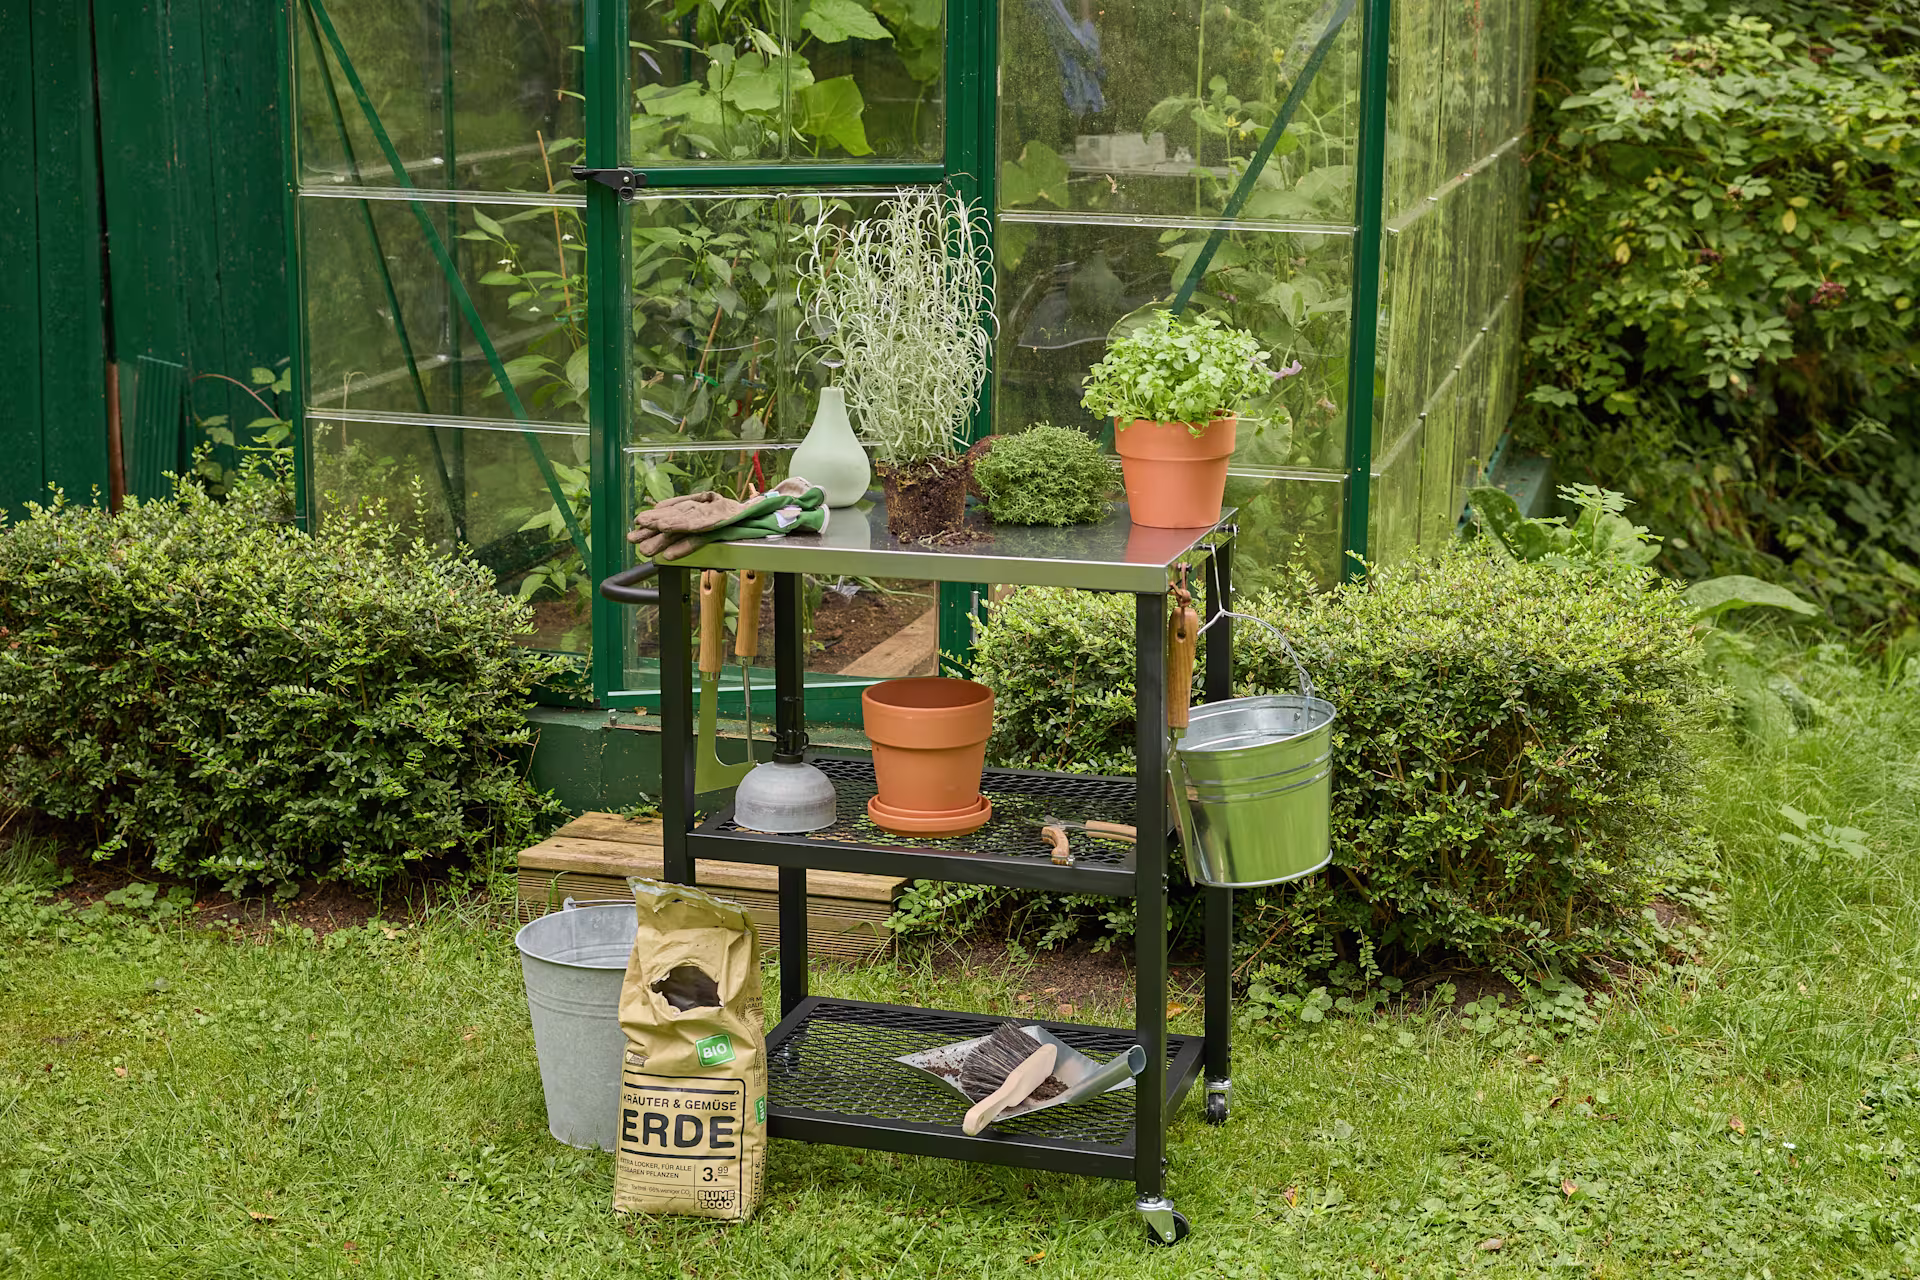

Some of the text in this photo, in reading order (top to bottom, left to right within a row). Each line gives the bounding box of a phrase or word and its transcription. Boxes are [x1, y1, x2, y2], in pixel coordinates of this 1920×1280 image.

[703, 1042, 727, 1059] BIO
[623, 1093, 737, 1110] KRÄUTER & GEMÜSE
[622, 1108, 736, 1149] ERDE
[635, 1160, 660, 1170] LOCKER,
[661, 1163, 674, 1171] FÜR
[646, 1170, 679, 1179] PFLANZEN
[697, 1189, 736, 1201] BLUME
[700, 1200, 734, 1210] 2000
